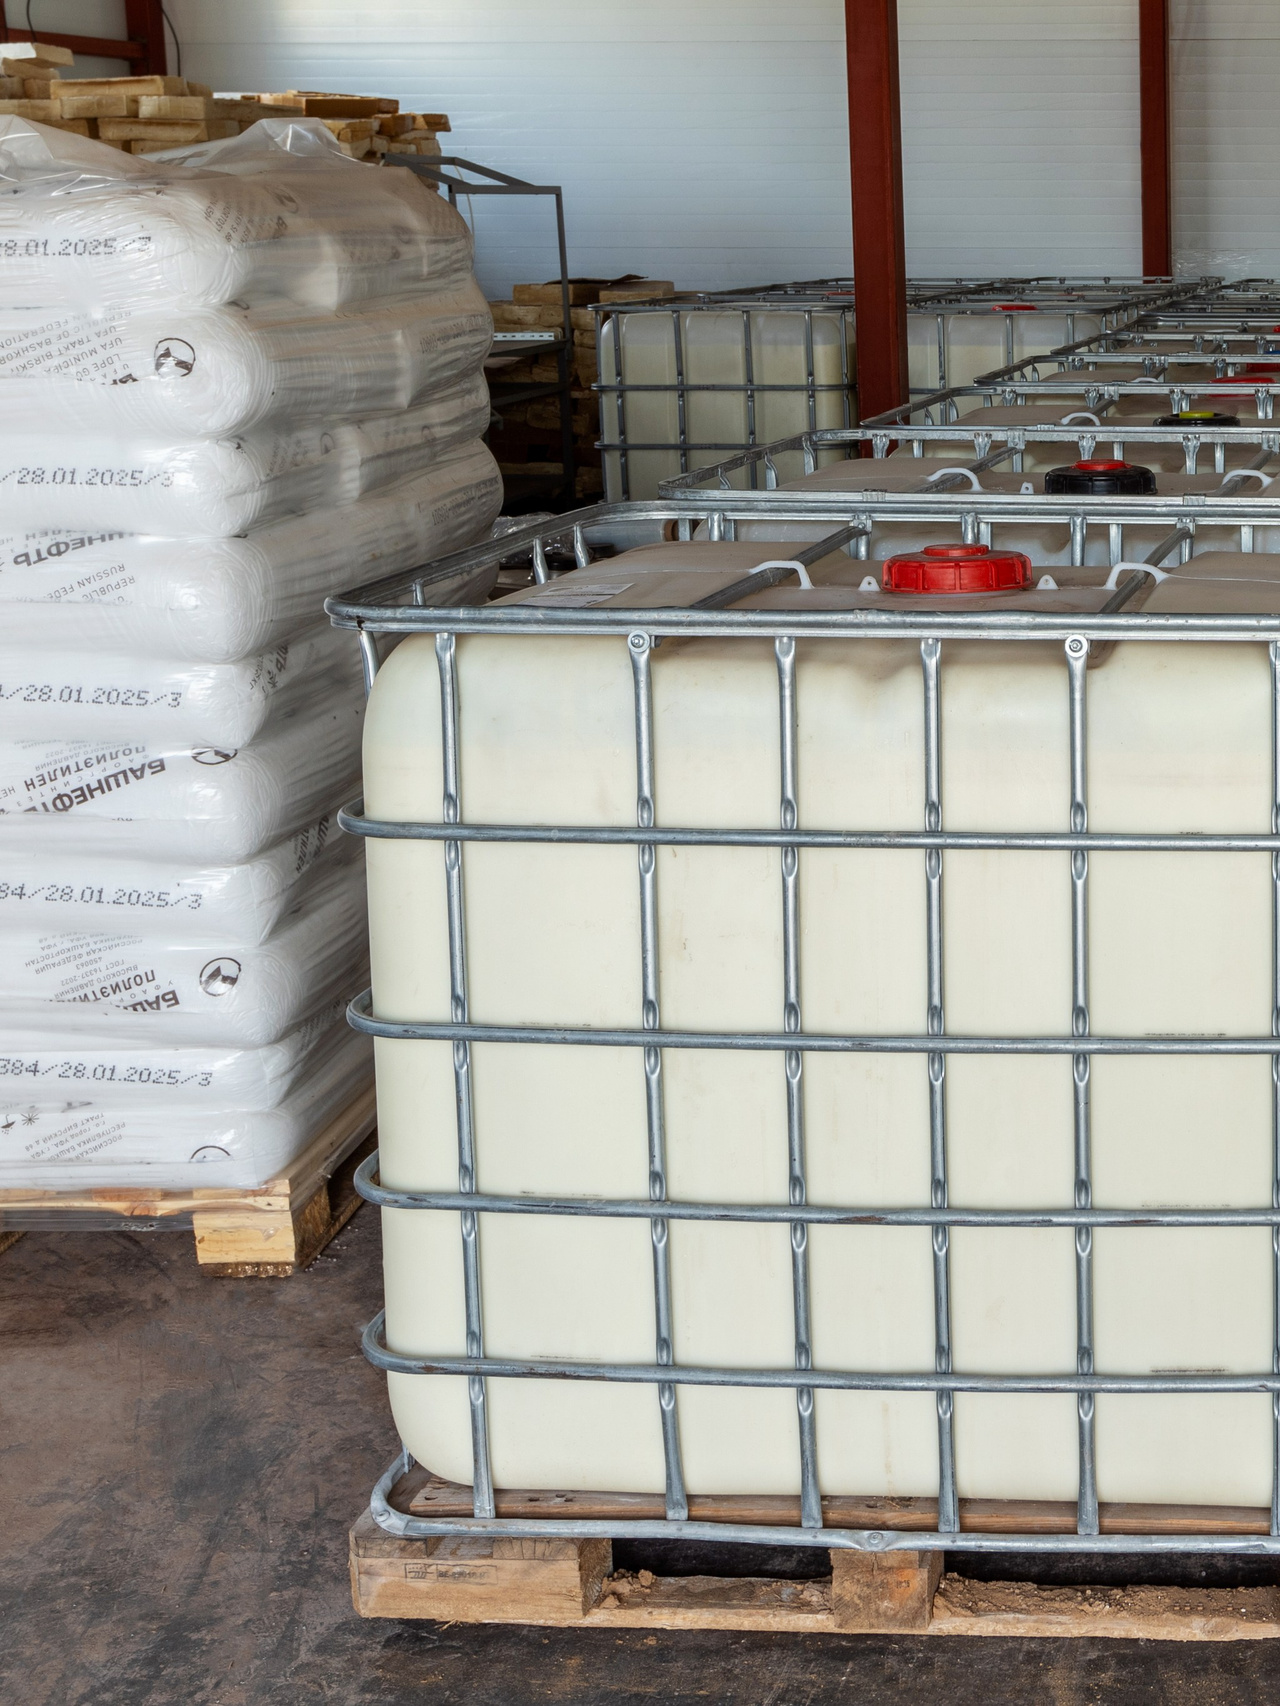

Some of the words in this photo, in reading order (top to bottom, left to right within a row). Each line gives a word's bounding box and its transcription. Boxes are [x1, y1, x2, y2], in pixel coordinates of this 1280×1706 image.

[0, 235, 152, 257] 8.01.2025/3
[56, 330, 70, 342] OF
[94, 325, 117, 339] UFA
[57, 335, 92, 356] TRAKT
[100, 337, 123, 352] UFA
[92, 353, 121, 372] LDPE
[77, 563, 126, 589] RUSSIAN
[24, 745, 146, 792] ПОЛИЭТИЛЕН
[24, 942, 91, 968] БАШКОРТОСТАН
[35, 952, 84, 975] ФЕДЕРАЦИЯ
[75, 956, 103, 971] 450063
[104, 958, 126, 972] ГОСТ
[60, 967, 103, 987] 16337-2022
[96, 964, 139, 984] ВЫСОКОГО
[53, 979, 96, 1000] ДАВЛЕНИЯ
[81, 1112, 105, 1127] ТРАКТ
[41, 1121, 79, 1144] БИРСКИЙ
[69, 1126, 92, 1141] город
[77, 1121, 127, 1148] РЕСПУБЛИКА
[24, 1144, 34, 1152] 68
[75, 1133, 124, 1159] РОССИЙСКАЯ
